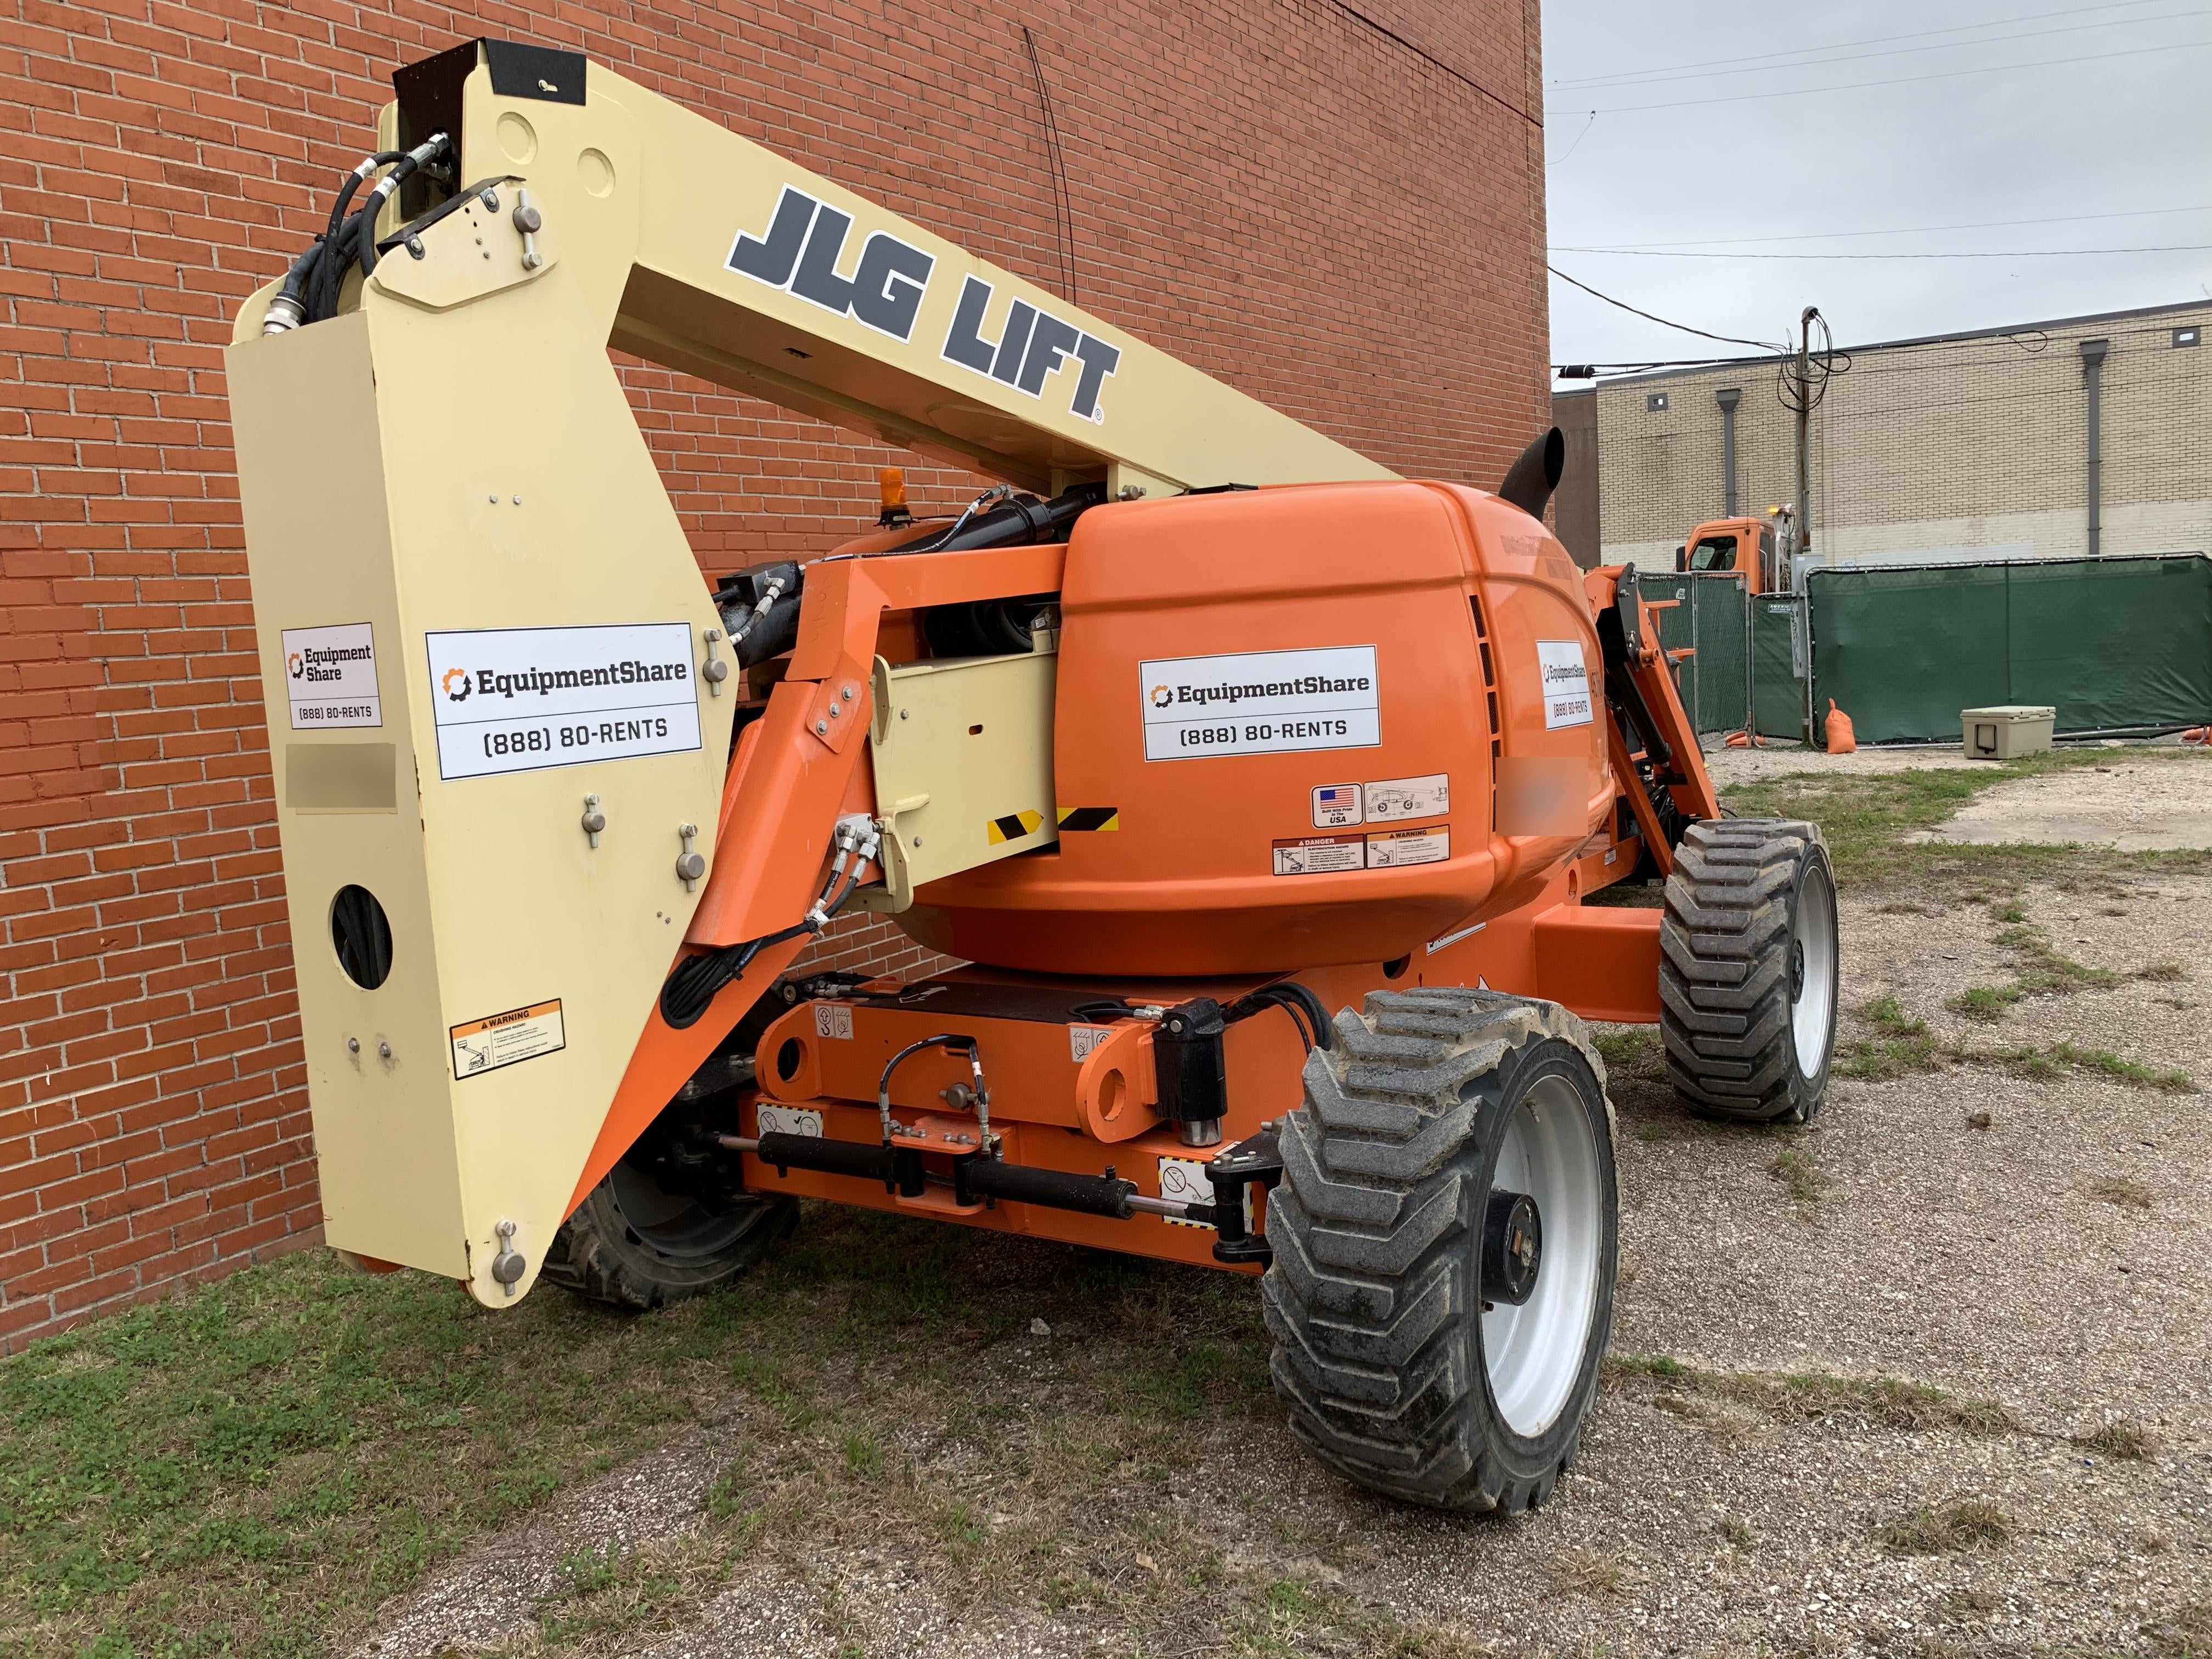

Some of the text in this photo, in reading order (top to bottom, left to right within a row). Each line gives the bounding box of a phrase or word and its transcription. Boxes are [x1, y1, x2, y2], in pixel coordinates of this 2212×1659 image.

[724, 183, 1121, 421] JLG LIFT
[304, 645, 372, 665] Equipment
[306, 666, 342, 683] Share
[477, 661, 687, 698] EquipmentShare
[1549, 664, 1585, 682] EquipmentShare
[1177, 676, 1370, 705] EquipmentShare
[298, 706, 372, 720] (888) 80-RENTS
[1554, 701, 1588, 718] (888) 80-RENTS
[483, 718, 668, 758] (888) 80-RENTS
[1180, 720, 1347, 746] (888) 80-RENTS
[1396, 830, 1426, 838] WARNING
[489, 1011, 529, 1026] WARNING
